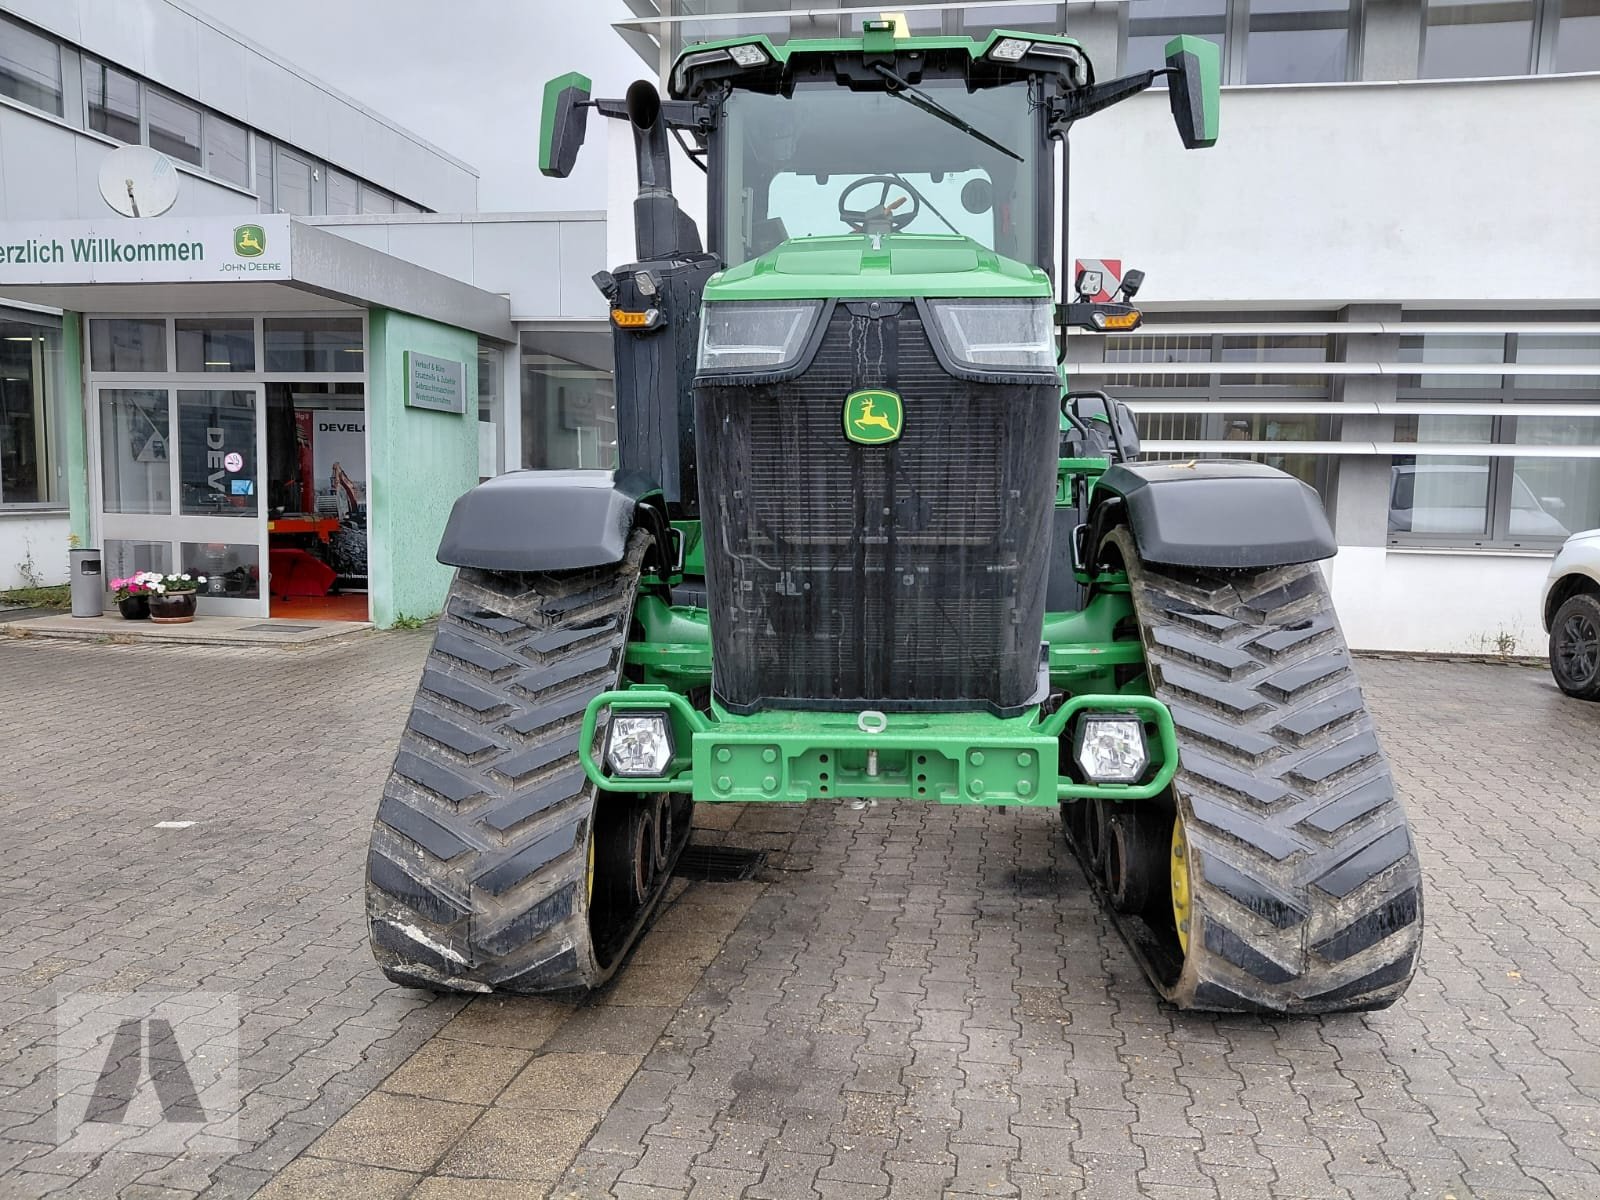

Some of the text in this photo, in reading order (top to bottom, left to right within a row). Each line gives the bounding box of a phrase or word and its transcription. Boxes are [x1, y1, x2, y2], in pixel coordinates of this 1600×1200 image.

[70, 239, 204, 263] Willkommen
[219, 262, 281, 272] JOHN DEERE
[318, 423, 366, 433] DEVEL
